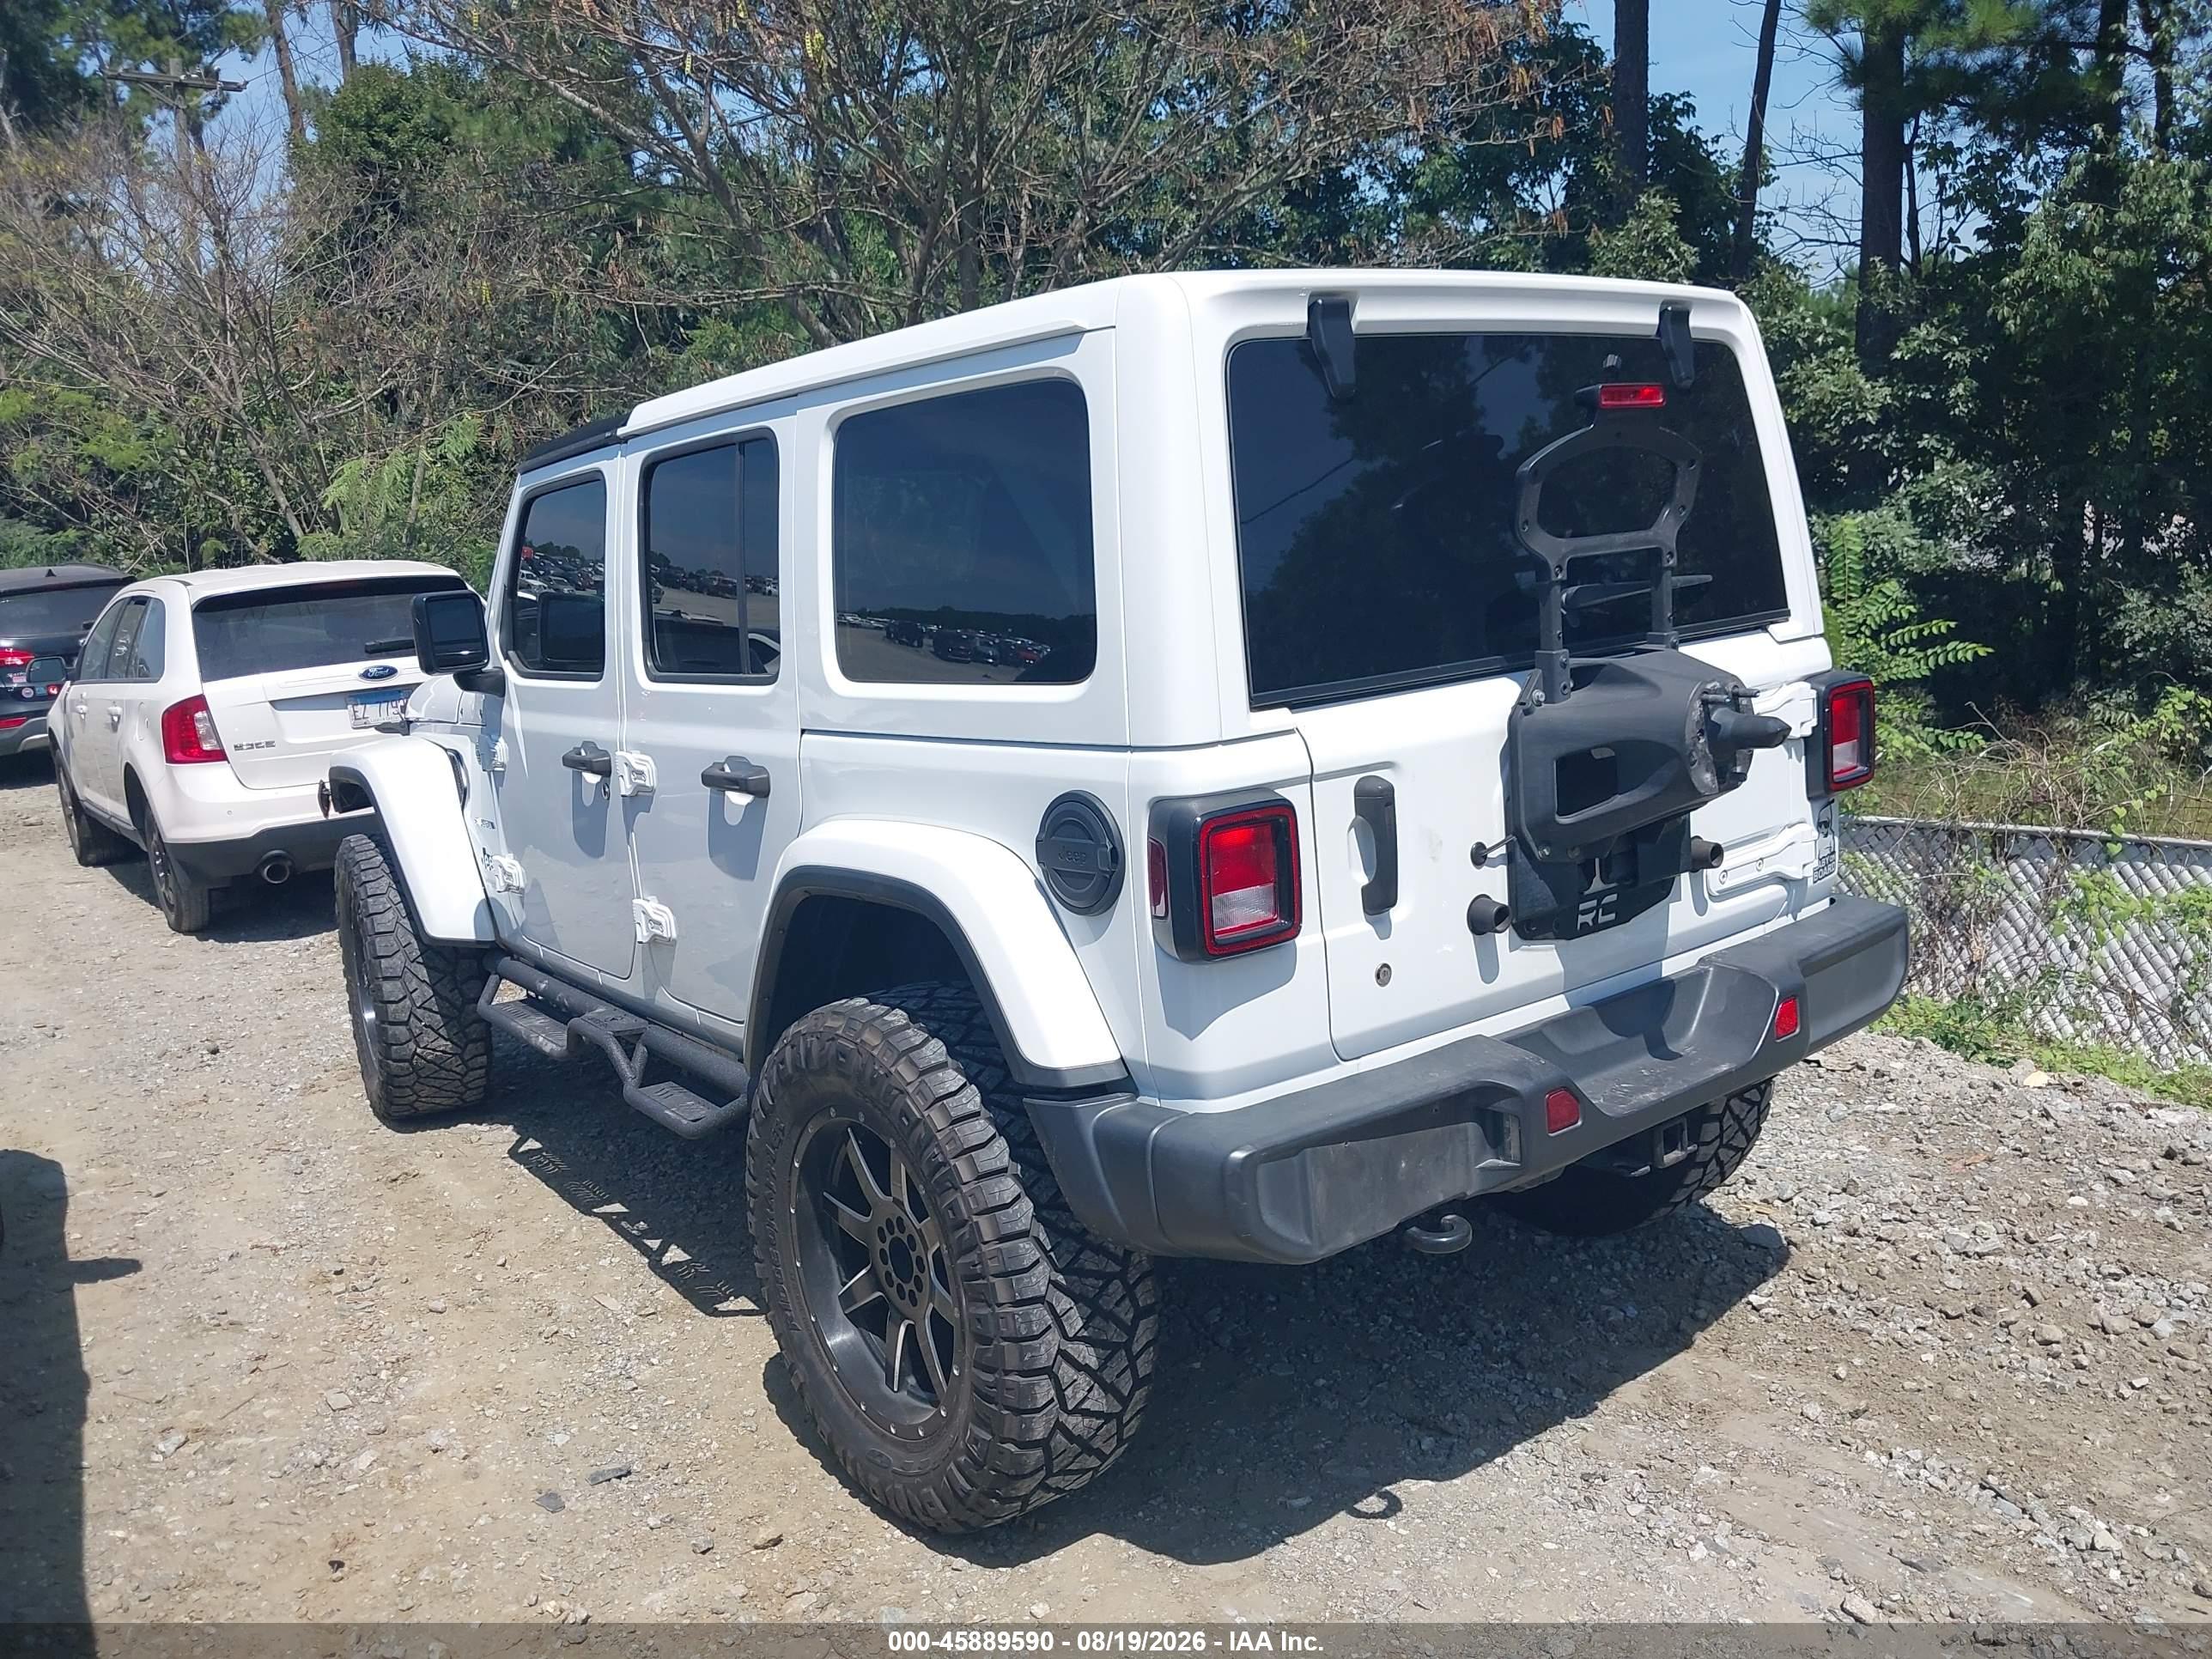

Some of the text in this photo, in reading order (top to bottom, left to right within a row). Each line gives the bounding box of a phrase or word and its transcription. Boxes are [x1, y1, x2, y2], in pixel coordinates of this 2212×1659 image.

[368, 666, 390, 678] Ford
[1814, 861, 1836, 883] BOARD
[1577, 893, 1618, 931] RC
